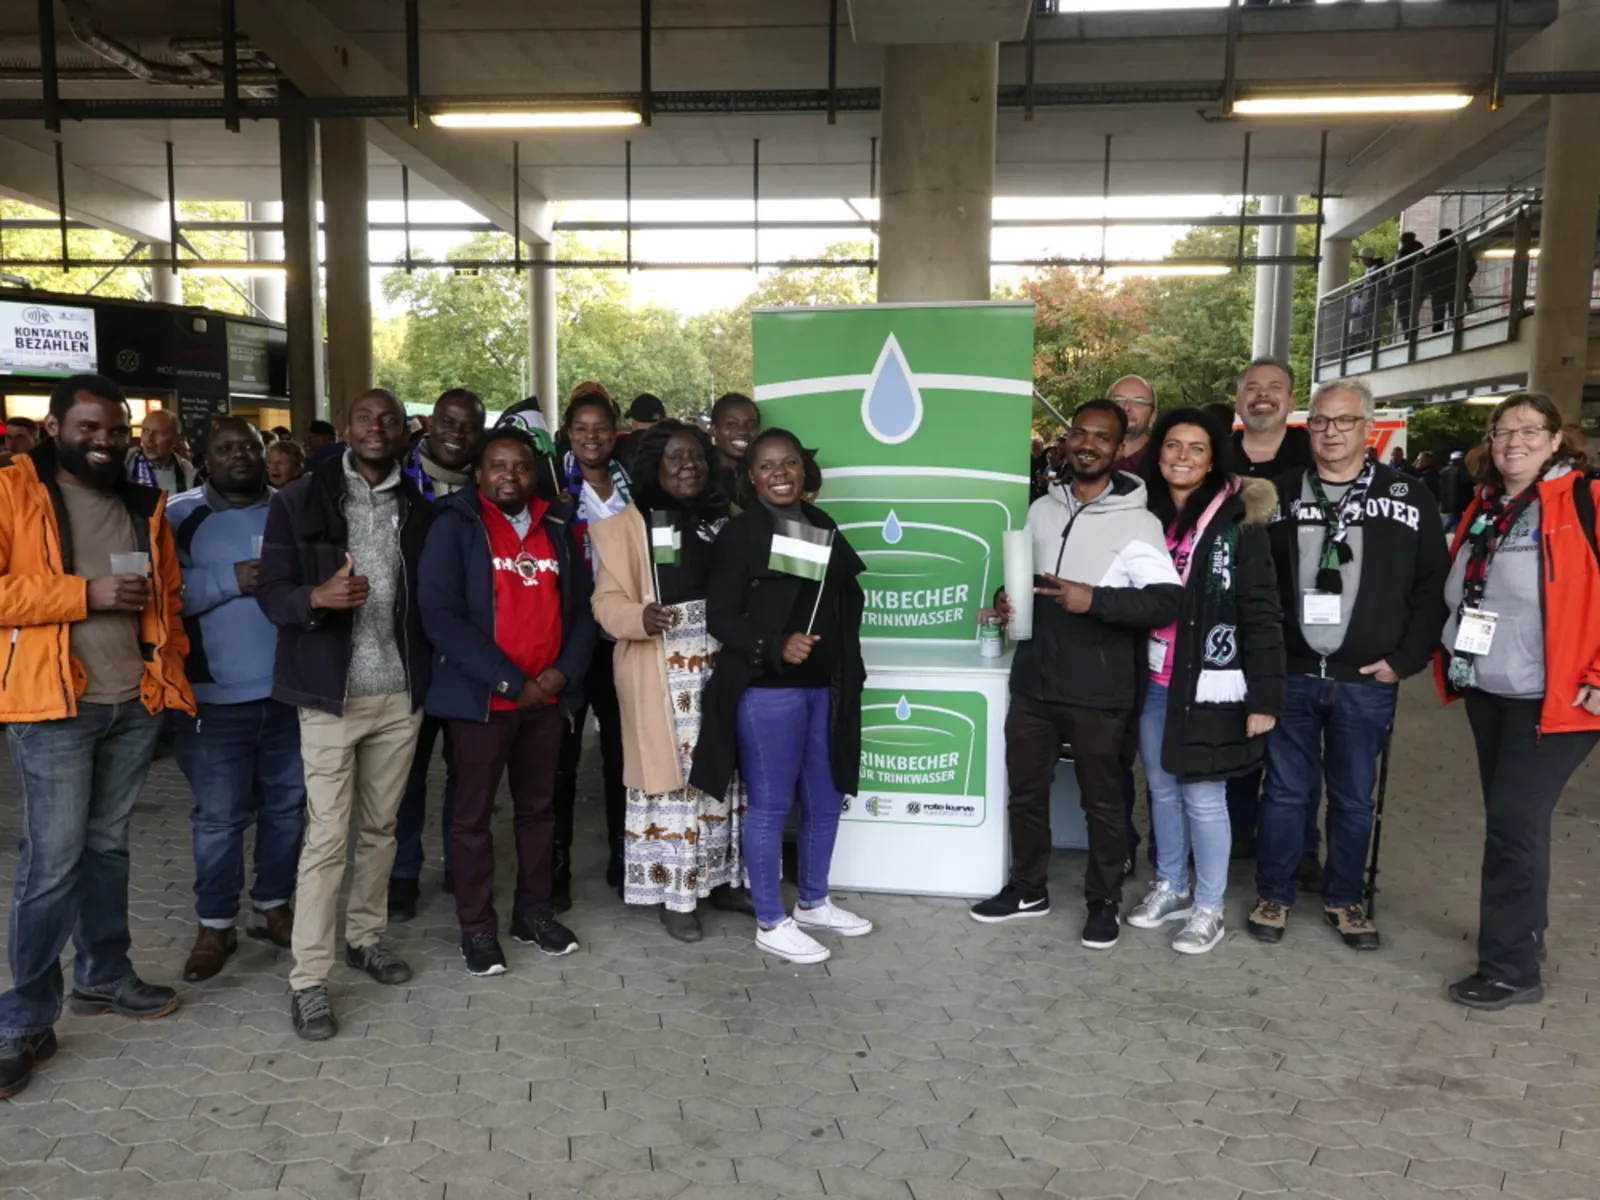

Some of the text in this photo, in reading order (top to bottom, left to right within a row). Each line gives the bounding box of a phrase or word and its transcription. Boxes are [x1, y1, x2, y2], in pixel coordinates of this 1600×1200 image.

[14, 326, 89, 341] KONTAKTLOS
[15, 337, 89, 353] BEZAHLEN
[863, 583, 969, 609] KBECHER
[862, 607, 964, 627] TRINKWASSER
[860, 750, 959, 771] RINKBECHER
[859, 766, 955, 784] ÜR TRINKWASSER
